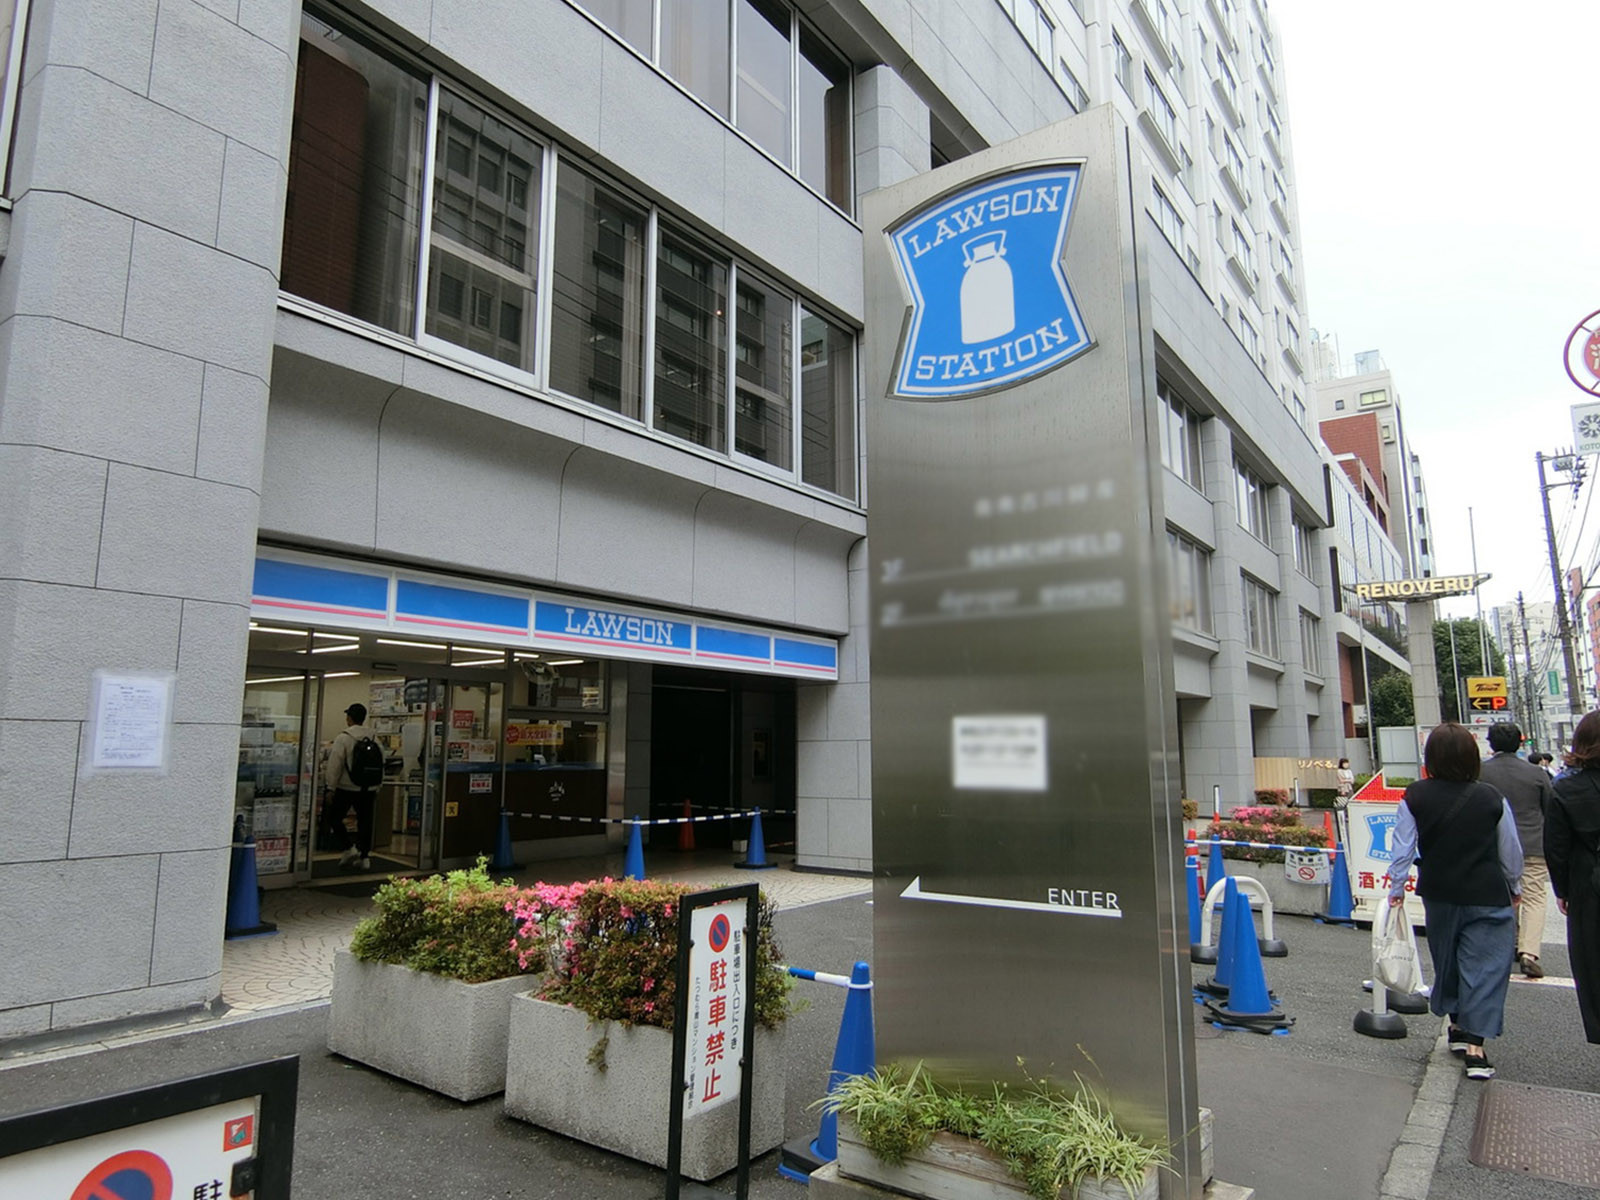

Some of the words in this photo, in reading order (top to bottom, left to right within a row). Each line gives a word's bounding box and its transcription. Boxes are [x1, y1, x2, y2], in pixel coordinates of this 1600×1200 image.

[908, 186, 1063, 259] LAWSON
[915, 318, 1070, 380] STATION
[1356, 575, 1475, 599] RENOVERU
[564, 607, 674, 646] LAWSON
[1492, 697, 1506, 710] P
[1369, 816, 1398, 825] LAWS
[1048, 888, 1120, 909] ENTER
[702, 957, 727, 1103] 駐車禁止
